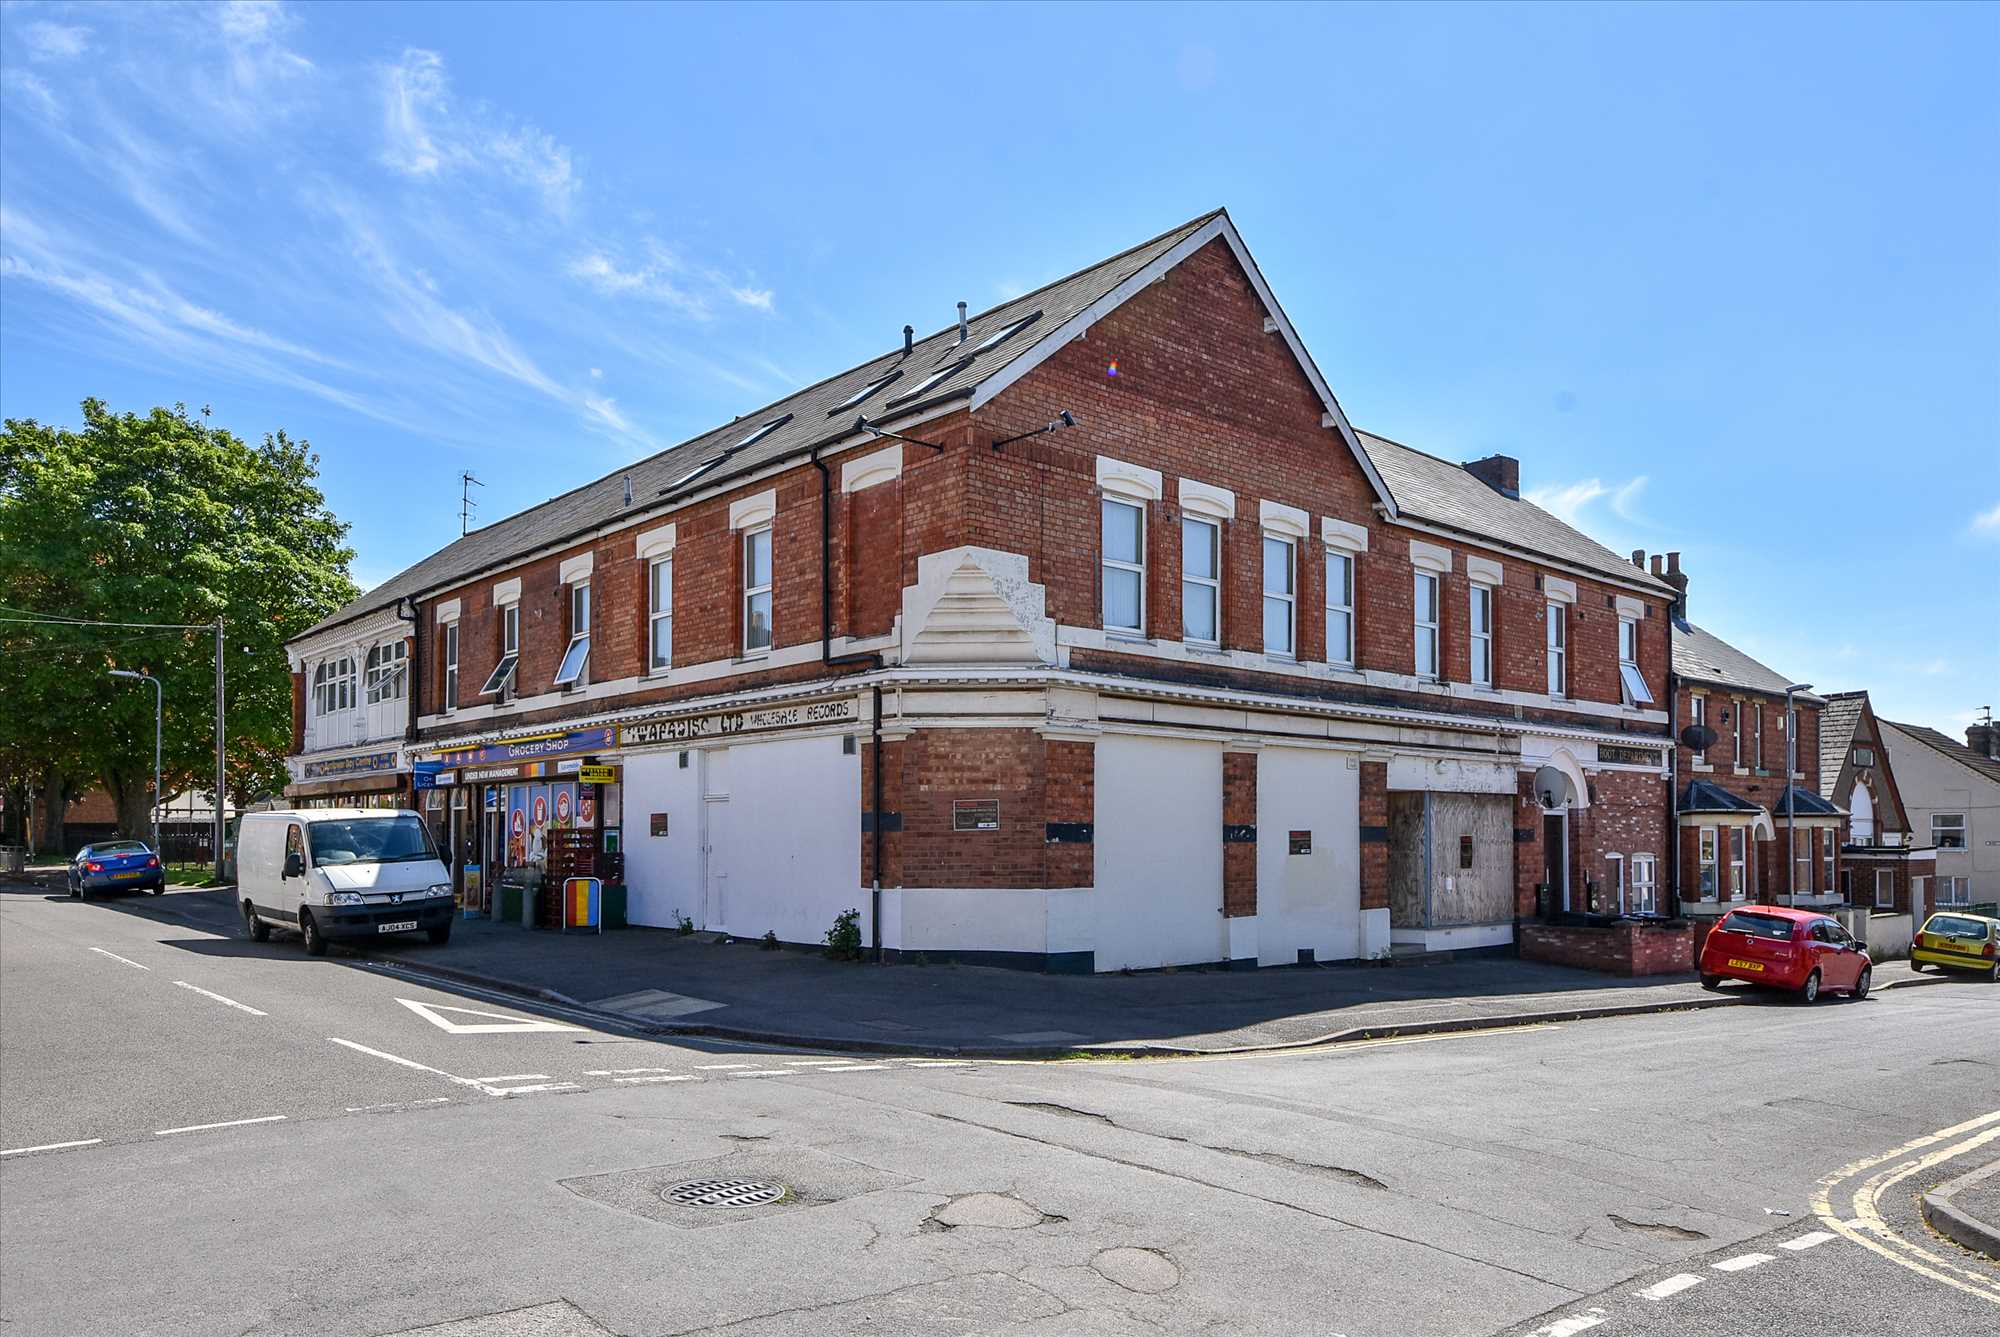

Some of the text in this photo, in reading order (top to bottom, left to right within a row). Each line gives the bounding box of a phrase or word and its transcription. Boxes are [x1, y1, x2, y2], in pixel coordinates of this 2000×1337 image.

[807, 701, 849, 720] RECORDS
[508, 738, 569, 757] GROCERY SHOP
[479, 769, 488, 780] NEW
[489, 767, 519, 778] MANAGEMENT
